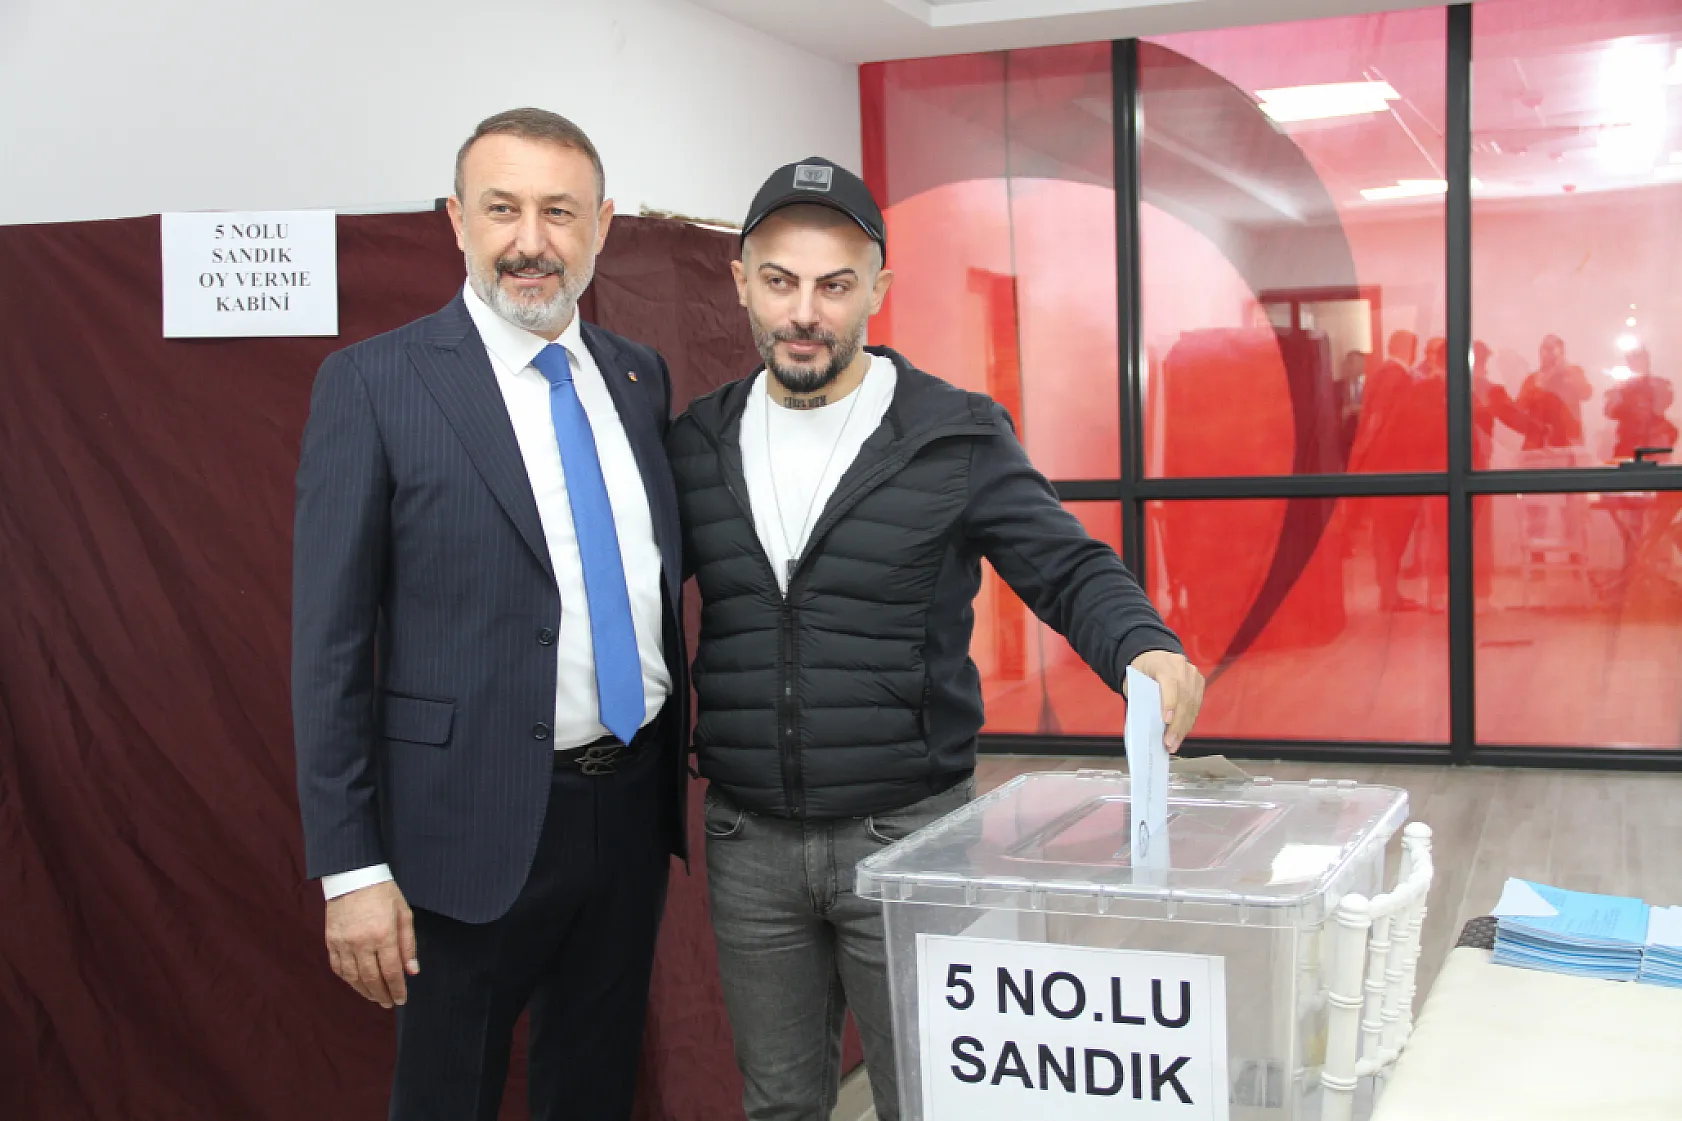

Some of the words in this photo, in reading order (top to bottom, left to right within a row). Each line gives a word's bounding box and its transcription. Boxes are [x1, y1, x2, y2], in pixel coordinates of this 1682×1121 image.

[214, 224, 224, 239] 5
[231, 224, 288, 239] NOLU
[212, 248, 292, 263] SANDIK
[199, 272, 228, 288] OY
[235, 271, 311, 287] VERME
[216, 292, 289, 312] KABİNİ
[945, 963, 975, 1011] 5
[996, 966, 1192, 1029] NO.LU
[950, 1035, 1194, 1106] SANDIK
